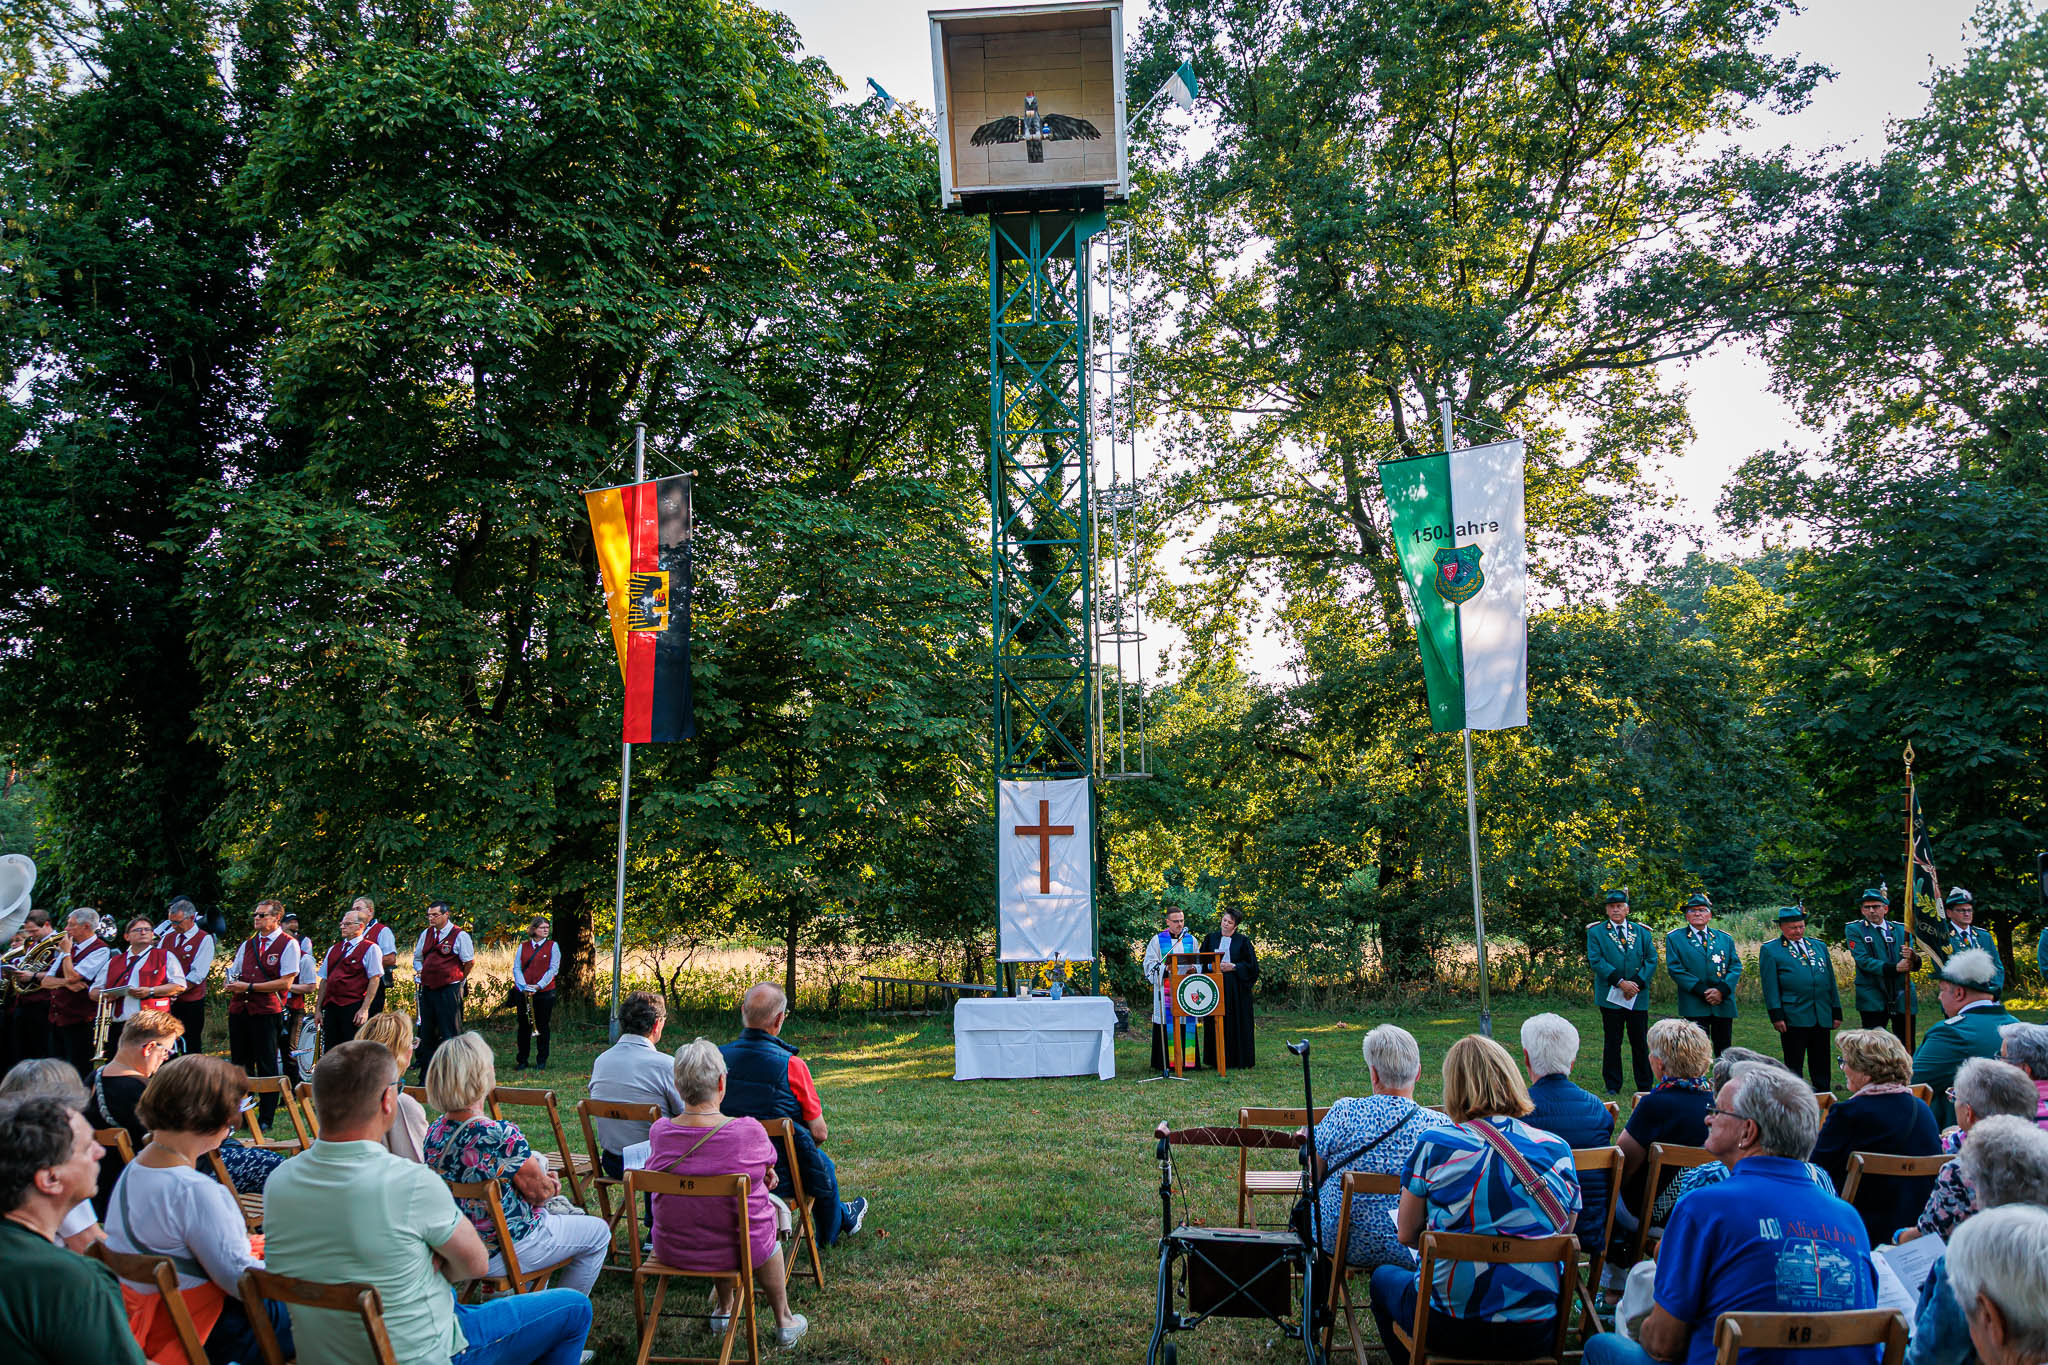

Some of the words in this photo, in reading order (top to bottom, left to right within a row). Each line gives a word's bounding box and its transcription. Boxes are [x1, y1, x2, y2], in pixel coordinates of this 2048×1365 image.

[679, 1179, 695, 1190] KB
[1491, 1240, 1512, 1254] KB
[1788, 1326, 1813, 1345] KB
